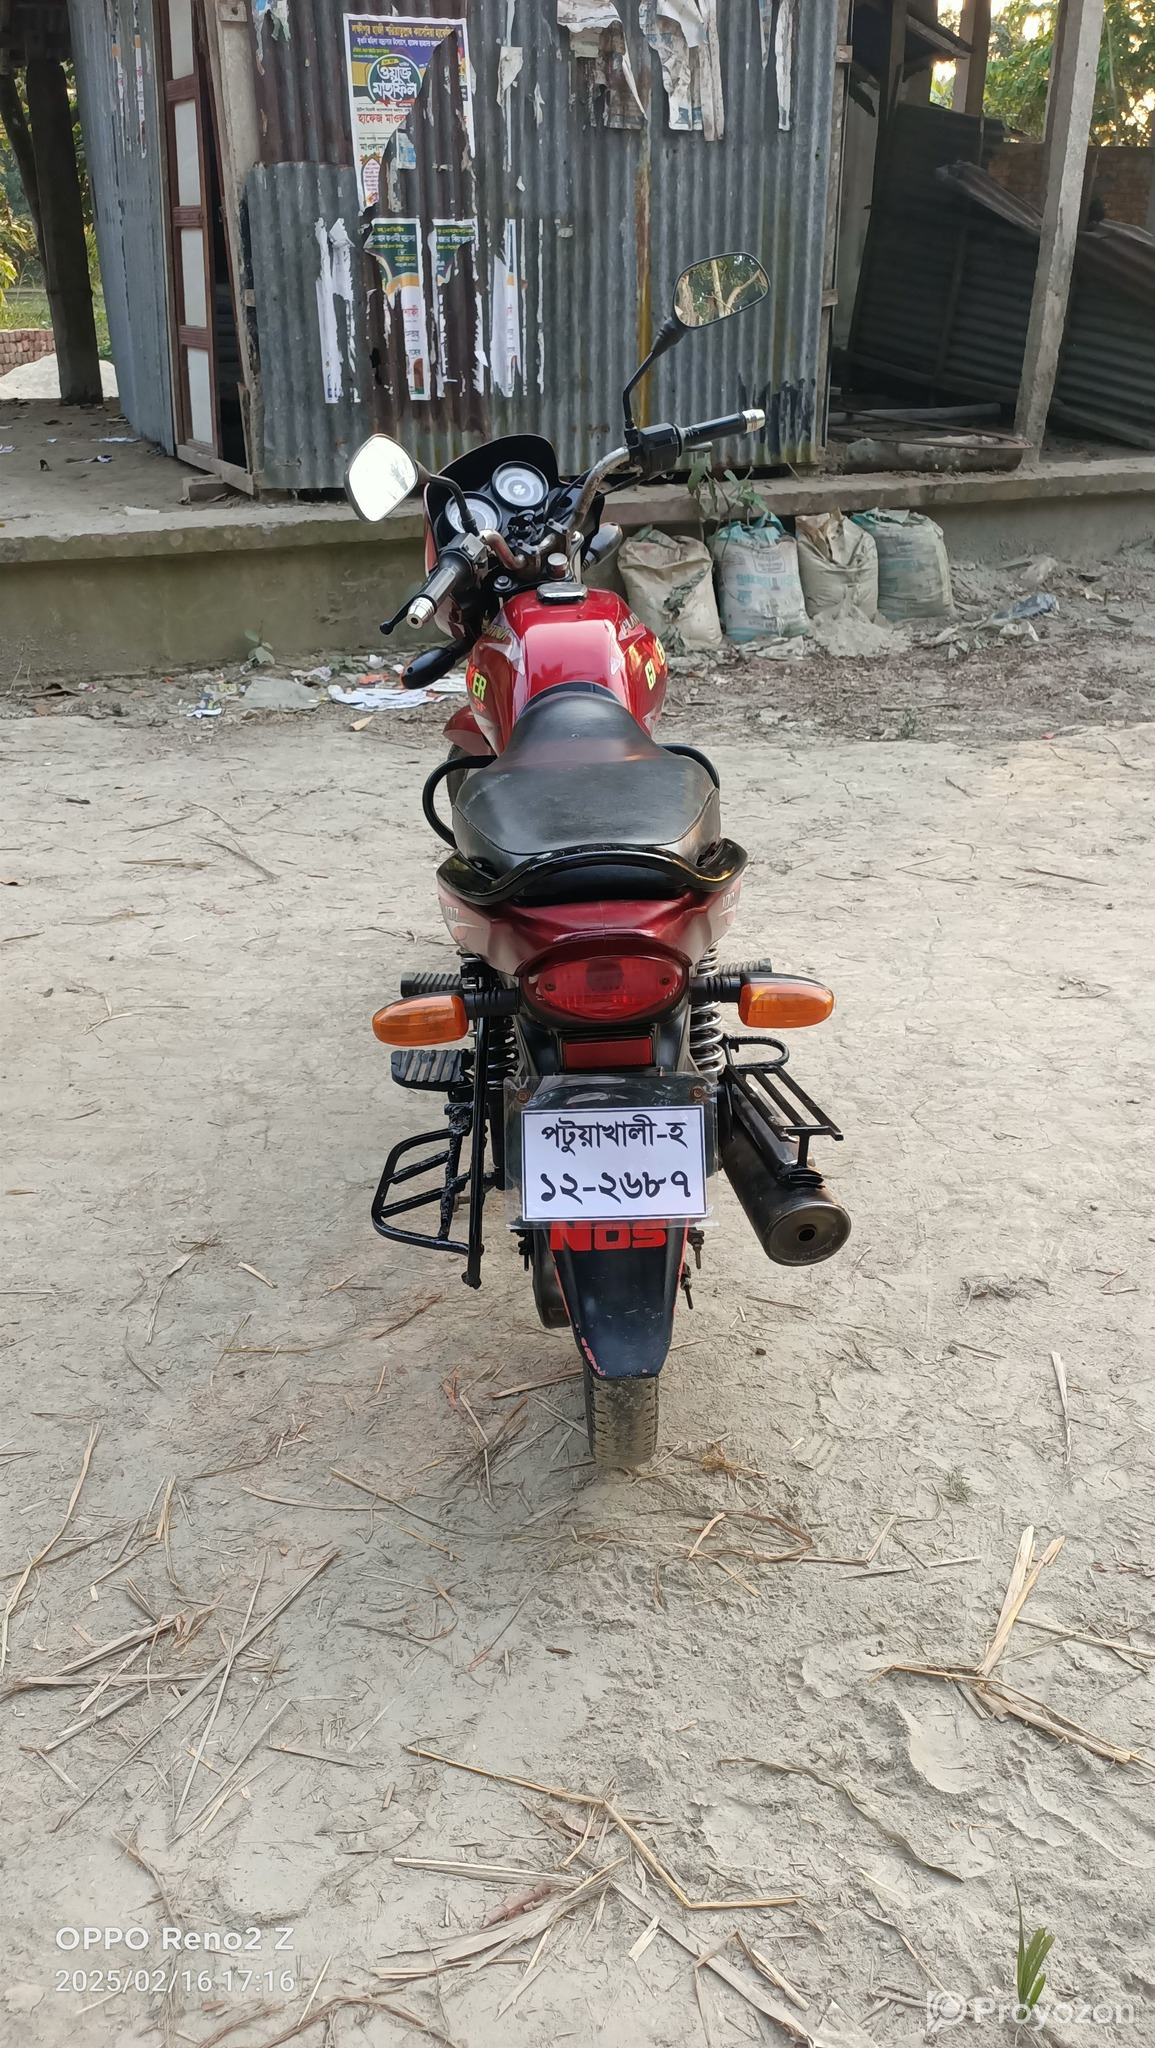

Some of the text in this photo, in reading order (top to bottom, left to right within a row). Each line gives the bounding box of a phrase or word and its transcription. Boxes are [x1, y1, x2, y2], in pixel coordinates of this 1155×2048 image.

[373, 80, 417, 101] মাহফিল
[357, 114, 383, 124] হাফেজ
[541, 1113, 689, 1157] পটুয়াখালী-হ
[540, 1170, 692, 1206] ১২-২৬৮৭
